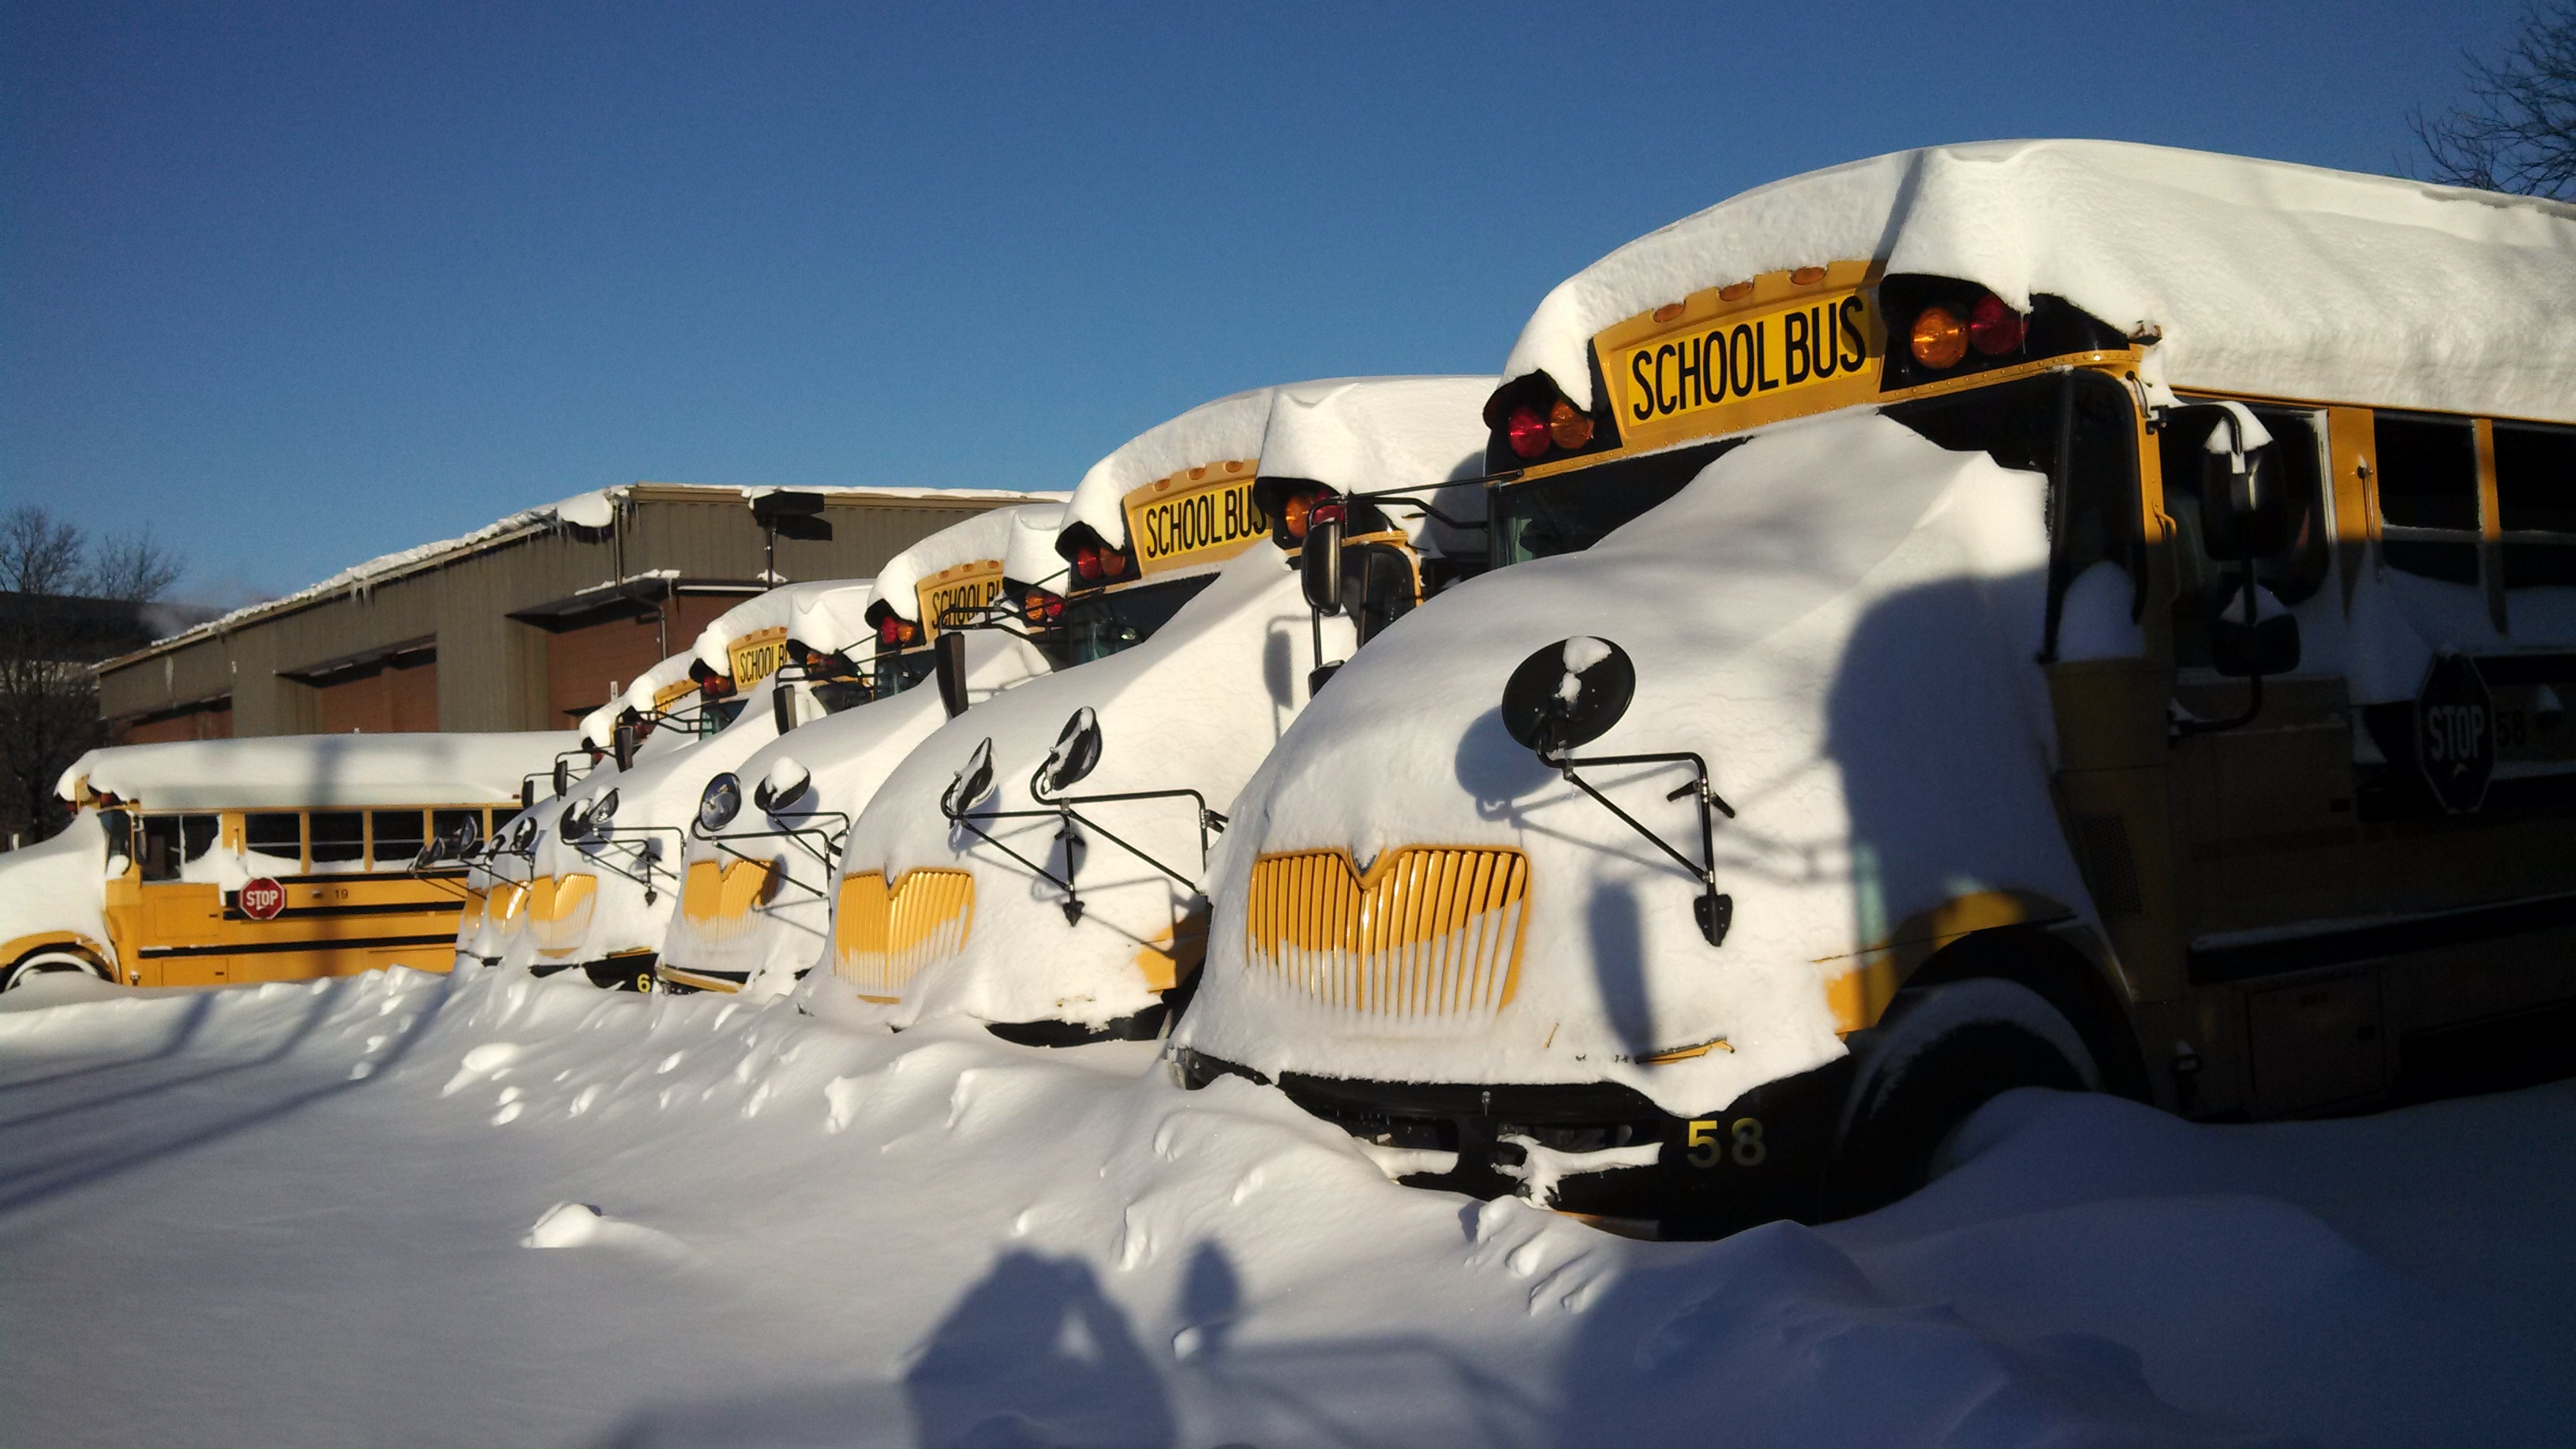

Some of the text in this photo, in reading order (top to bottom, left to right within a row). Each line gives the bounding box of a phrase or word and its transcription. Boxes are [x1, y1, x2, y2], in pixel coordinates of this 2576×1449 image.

[1632, 295, 1867, 421] SCHOOL BUS
[1145, 494, 1222, 558] SCHOOL
[2428, 704, 2485, 761] STOP
[2497, 711, 2525, 747] 58
[246, 889, 279, 907] STOP
[335, 889, 349, 899] 19
[1687, 1117, 1766, 1169] 58
